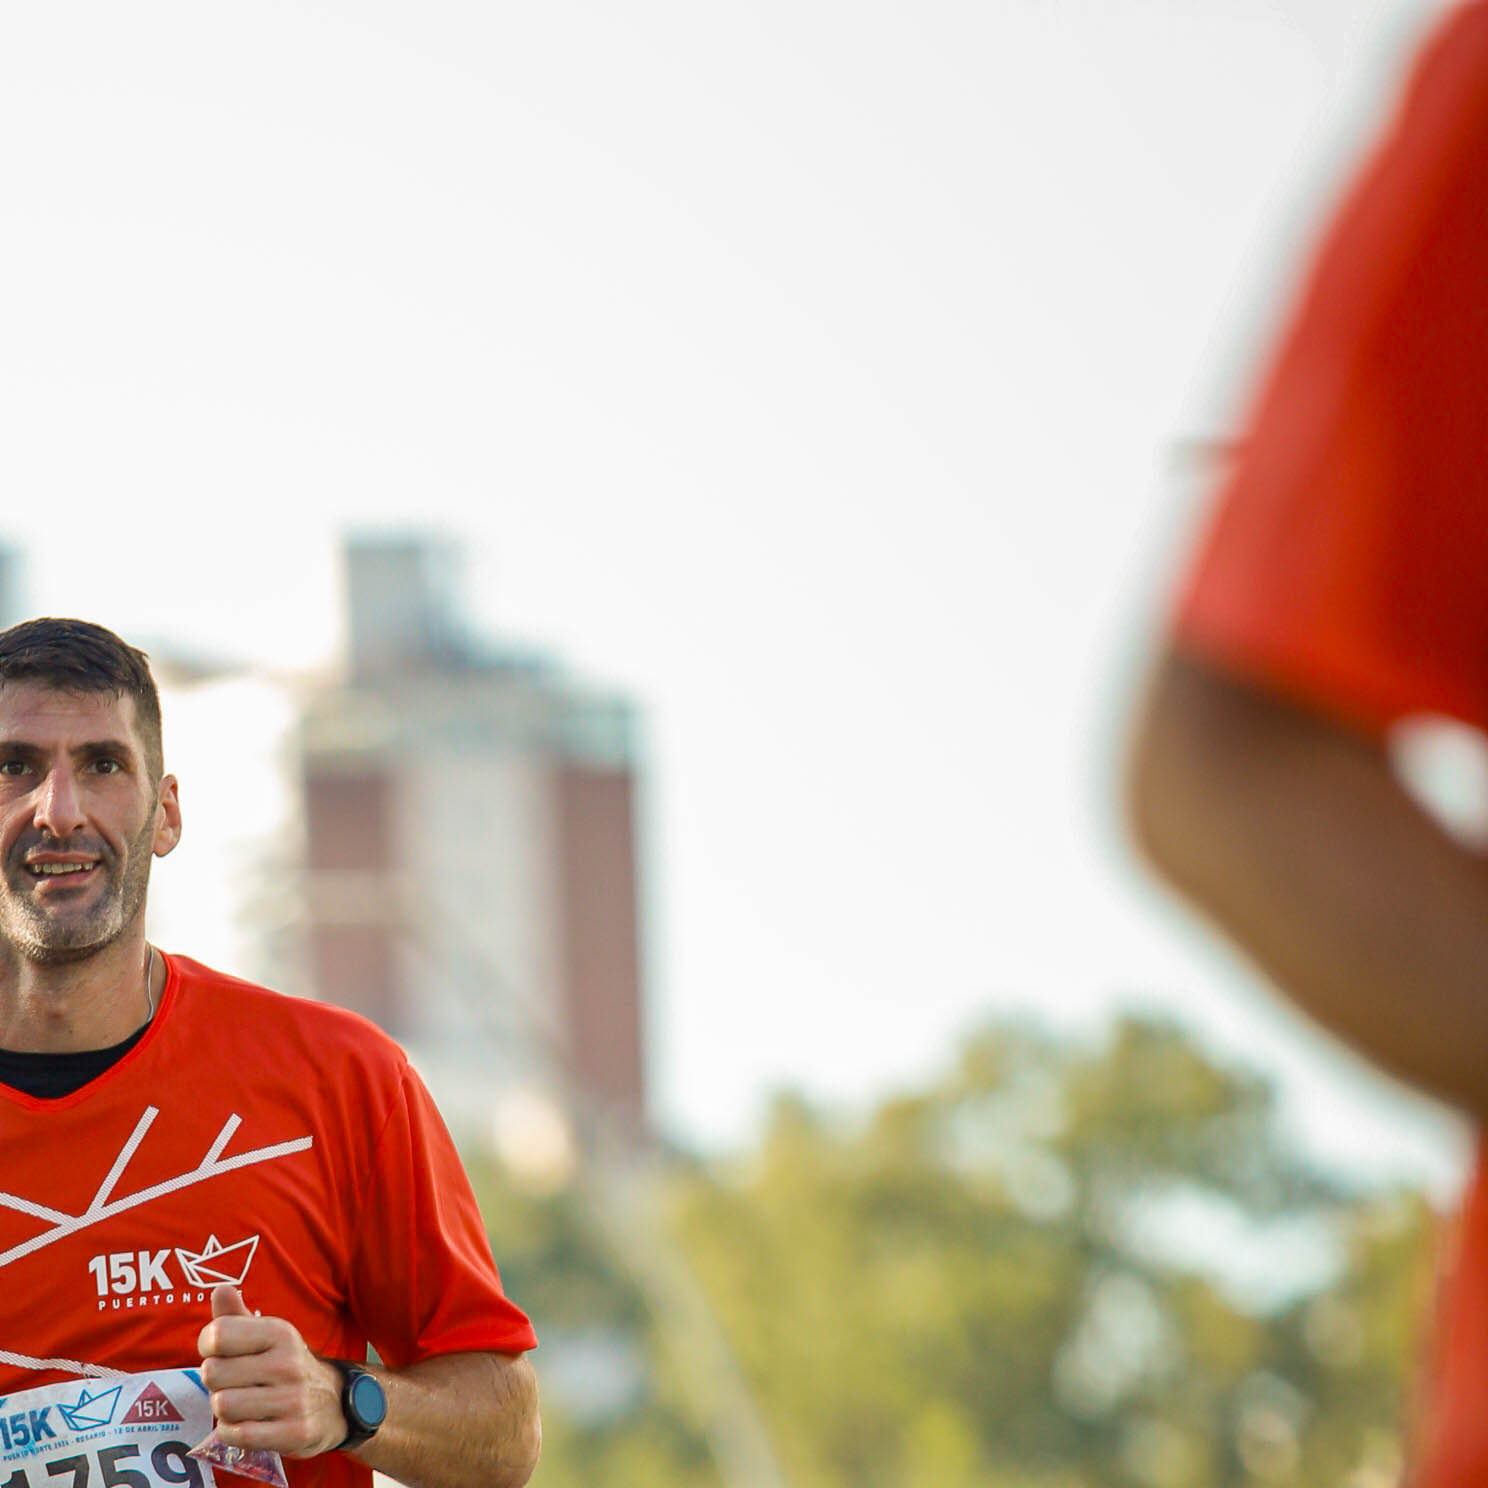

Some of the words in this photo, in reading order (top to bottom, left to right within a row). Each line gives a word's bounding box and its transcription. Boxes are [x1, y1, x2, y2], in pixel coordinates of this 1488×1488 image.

[88, 1249, 174, 1296] 15K
[98, 1293, 174, 1311] PUERTO
[135, 1400, 169, 1417] 15K
